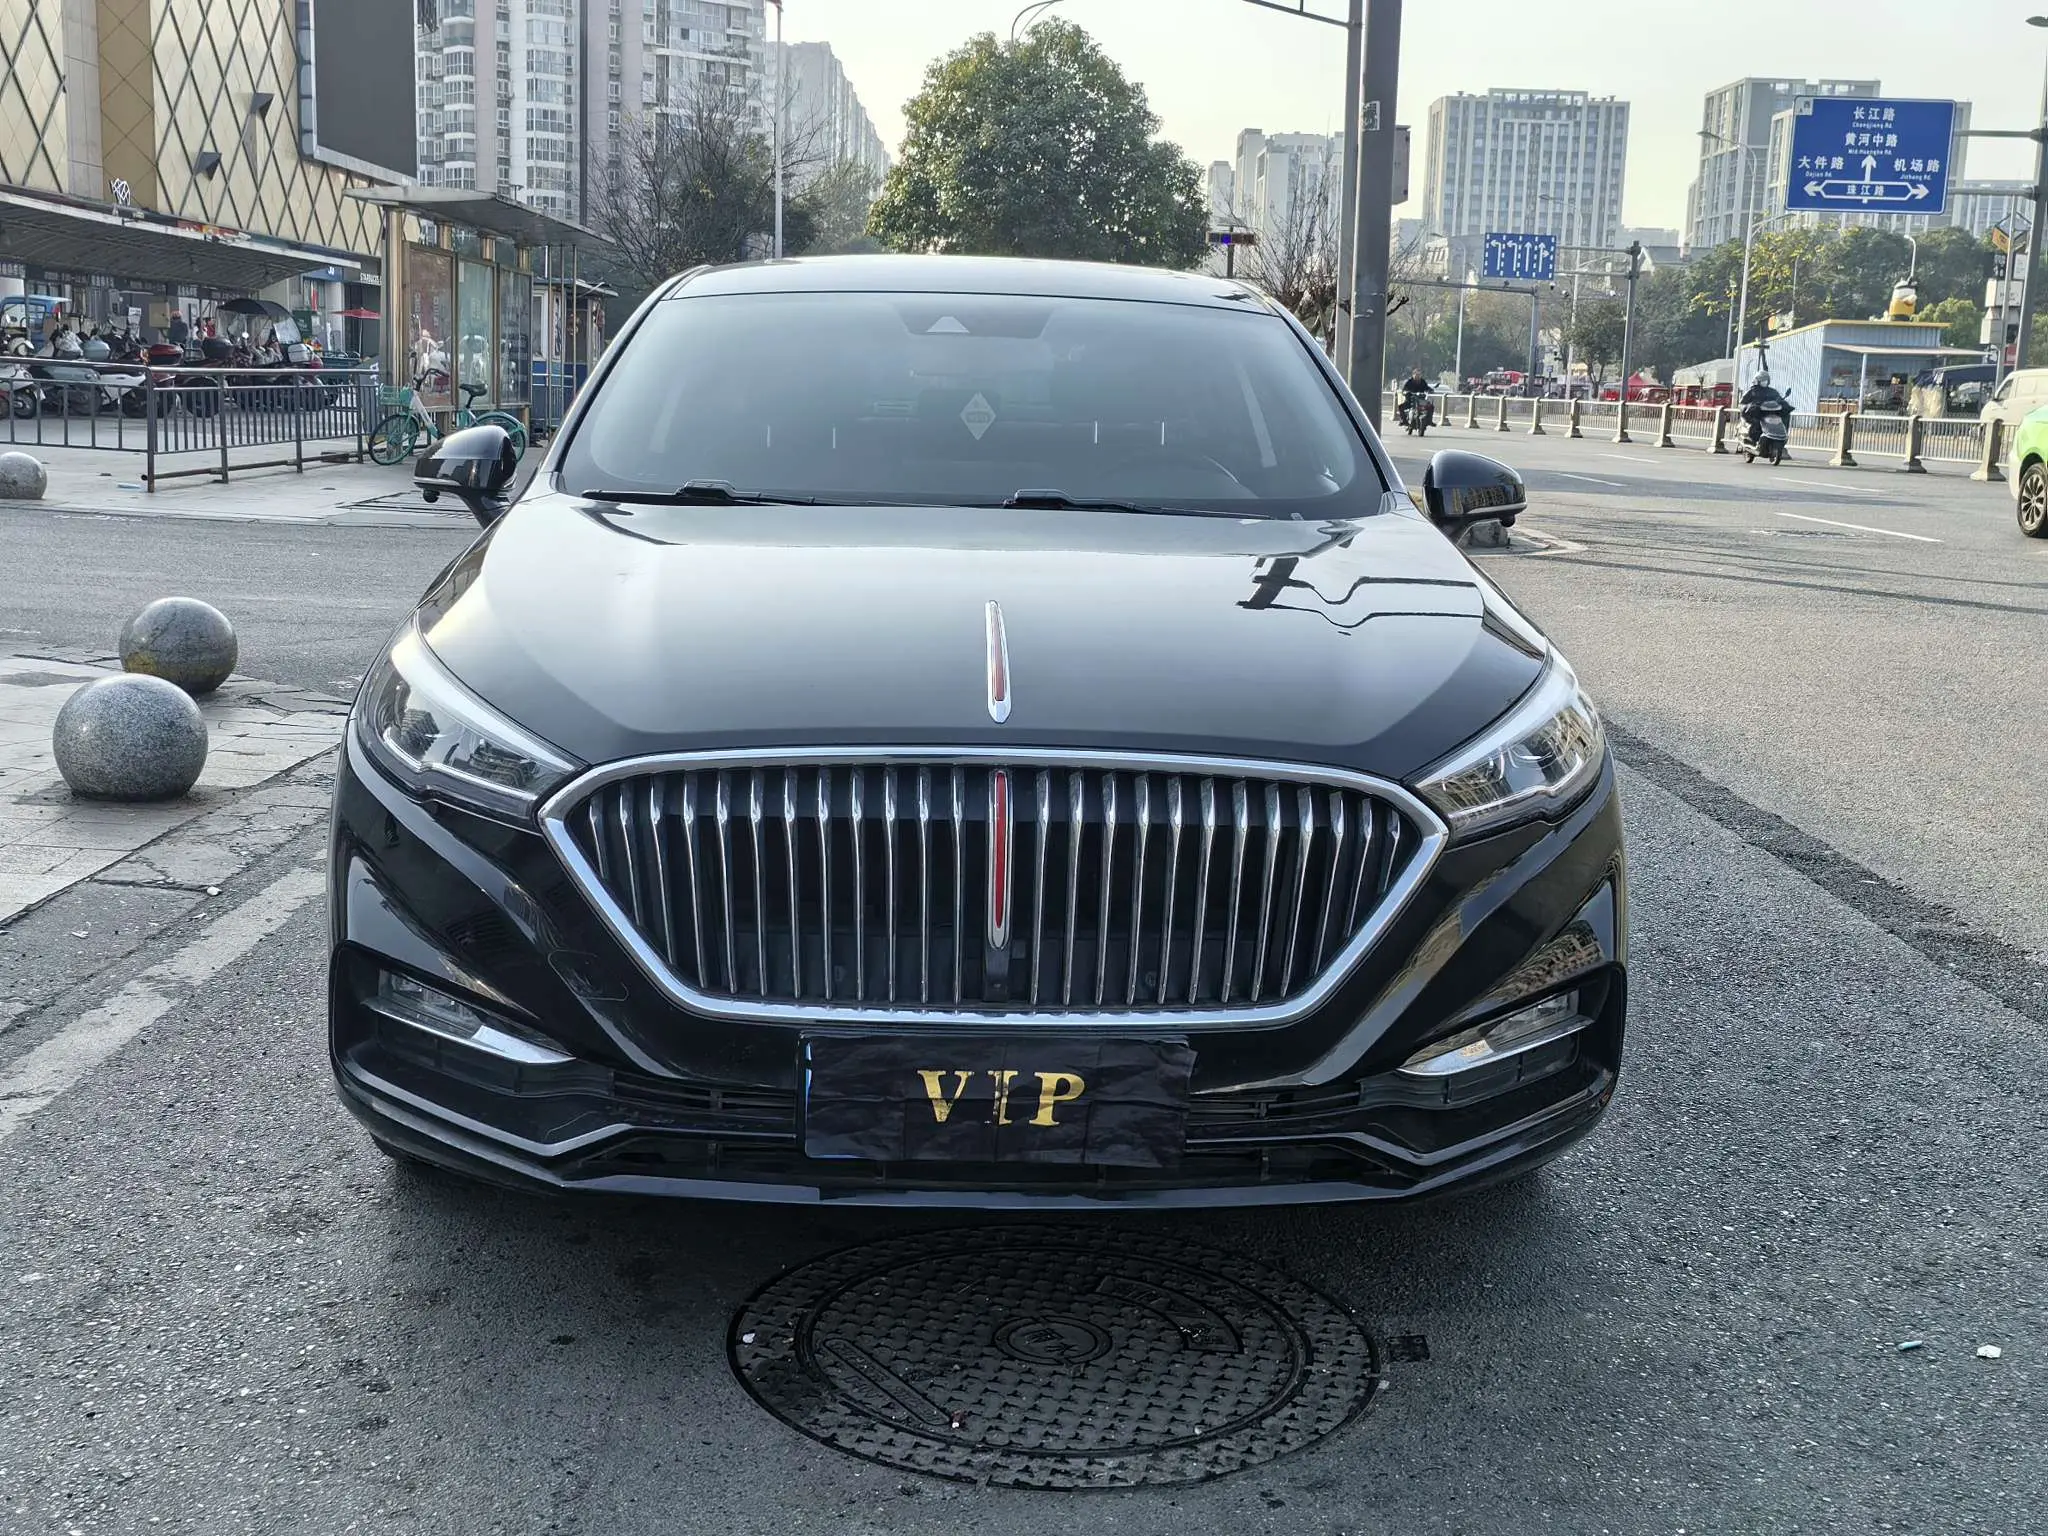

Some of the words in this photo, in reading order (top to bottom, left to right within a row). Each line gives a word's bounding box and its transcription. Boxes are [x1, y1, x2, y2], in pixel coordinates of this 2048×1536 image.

[1853, 106, 1896, 121] 长江路
[1844, 132, 1898, 148] 黄河中路
[1798, 155, 1845, 170] 大件路
[1894, 158, 1940, 172] 机场路
[1846, 184, 1884, 196] 珠江路
[917, 1069, 1086, 1127] VIP
